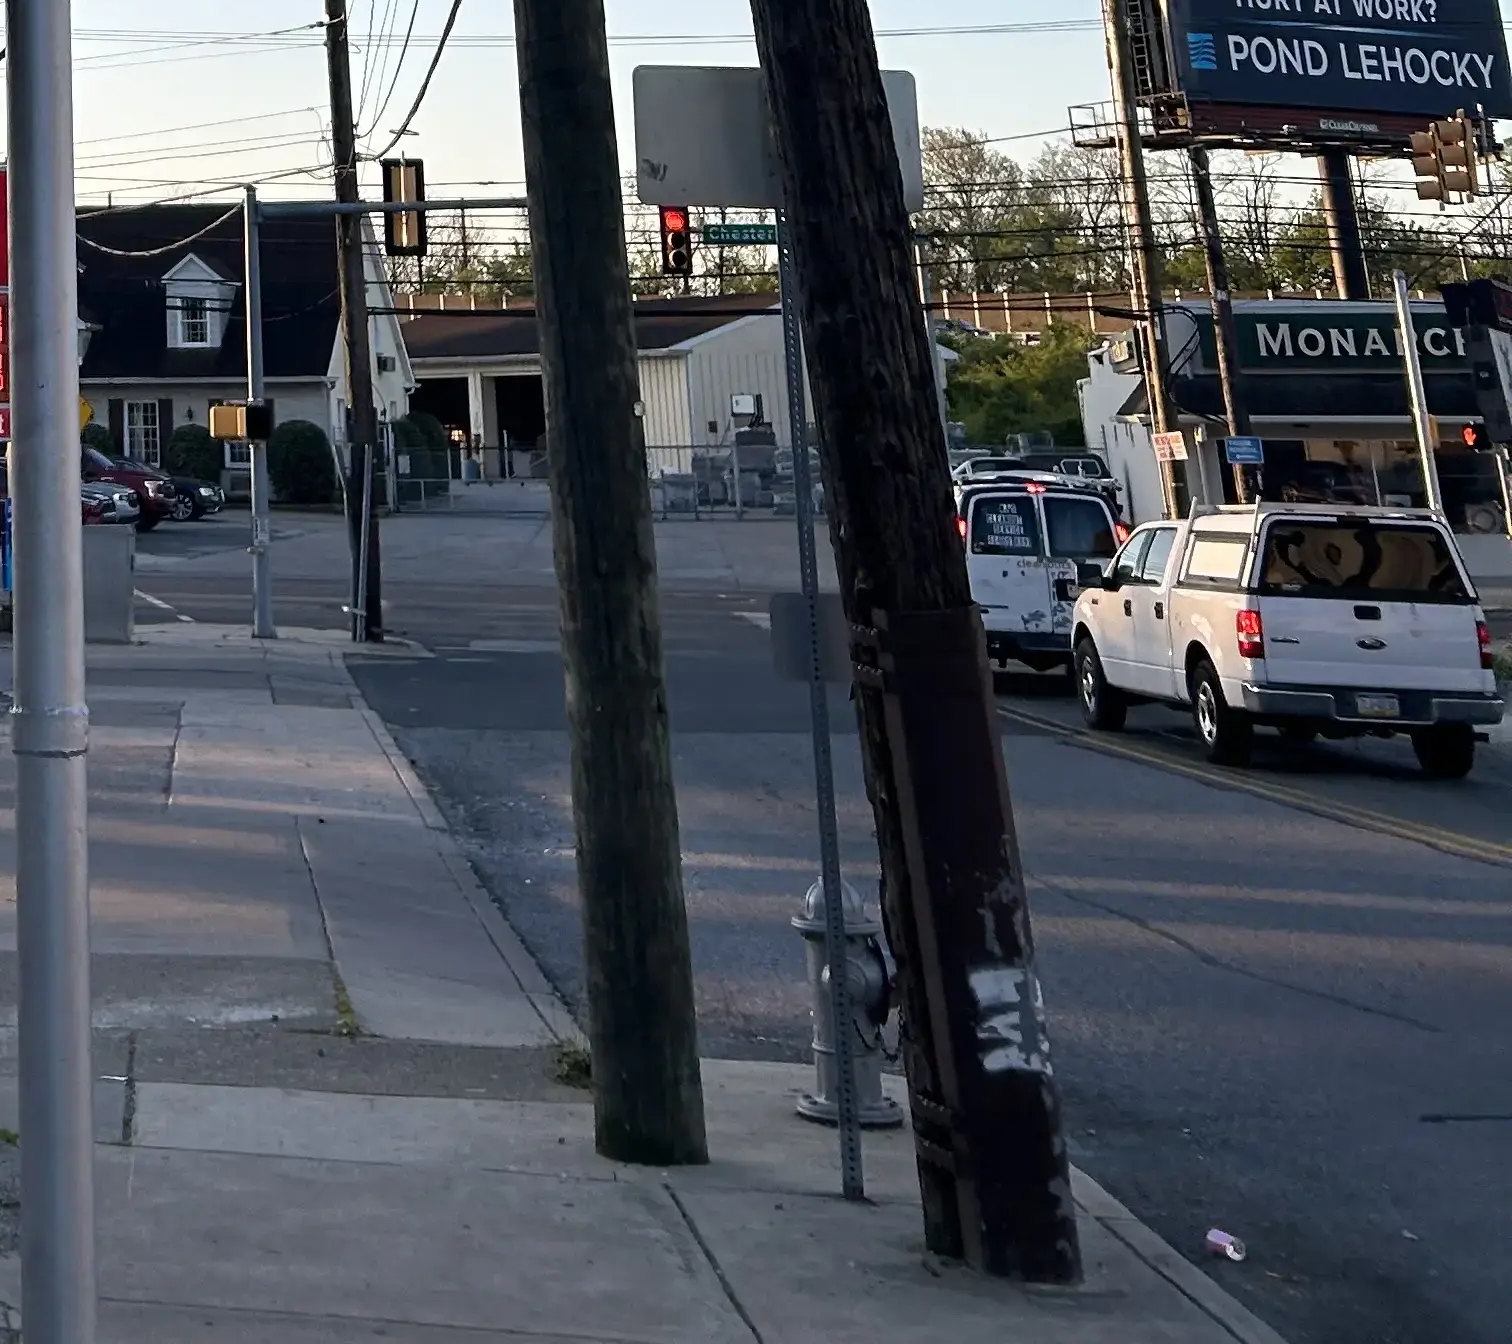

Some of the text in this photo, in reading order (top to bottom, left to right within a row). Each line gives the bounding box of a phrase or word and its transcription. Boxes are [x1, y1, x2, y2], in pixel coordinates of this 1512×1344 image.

[1226, 34, 1494, 90] POND LEHOCKY
[708, 226, 774, 241] Chester
